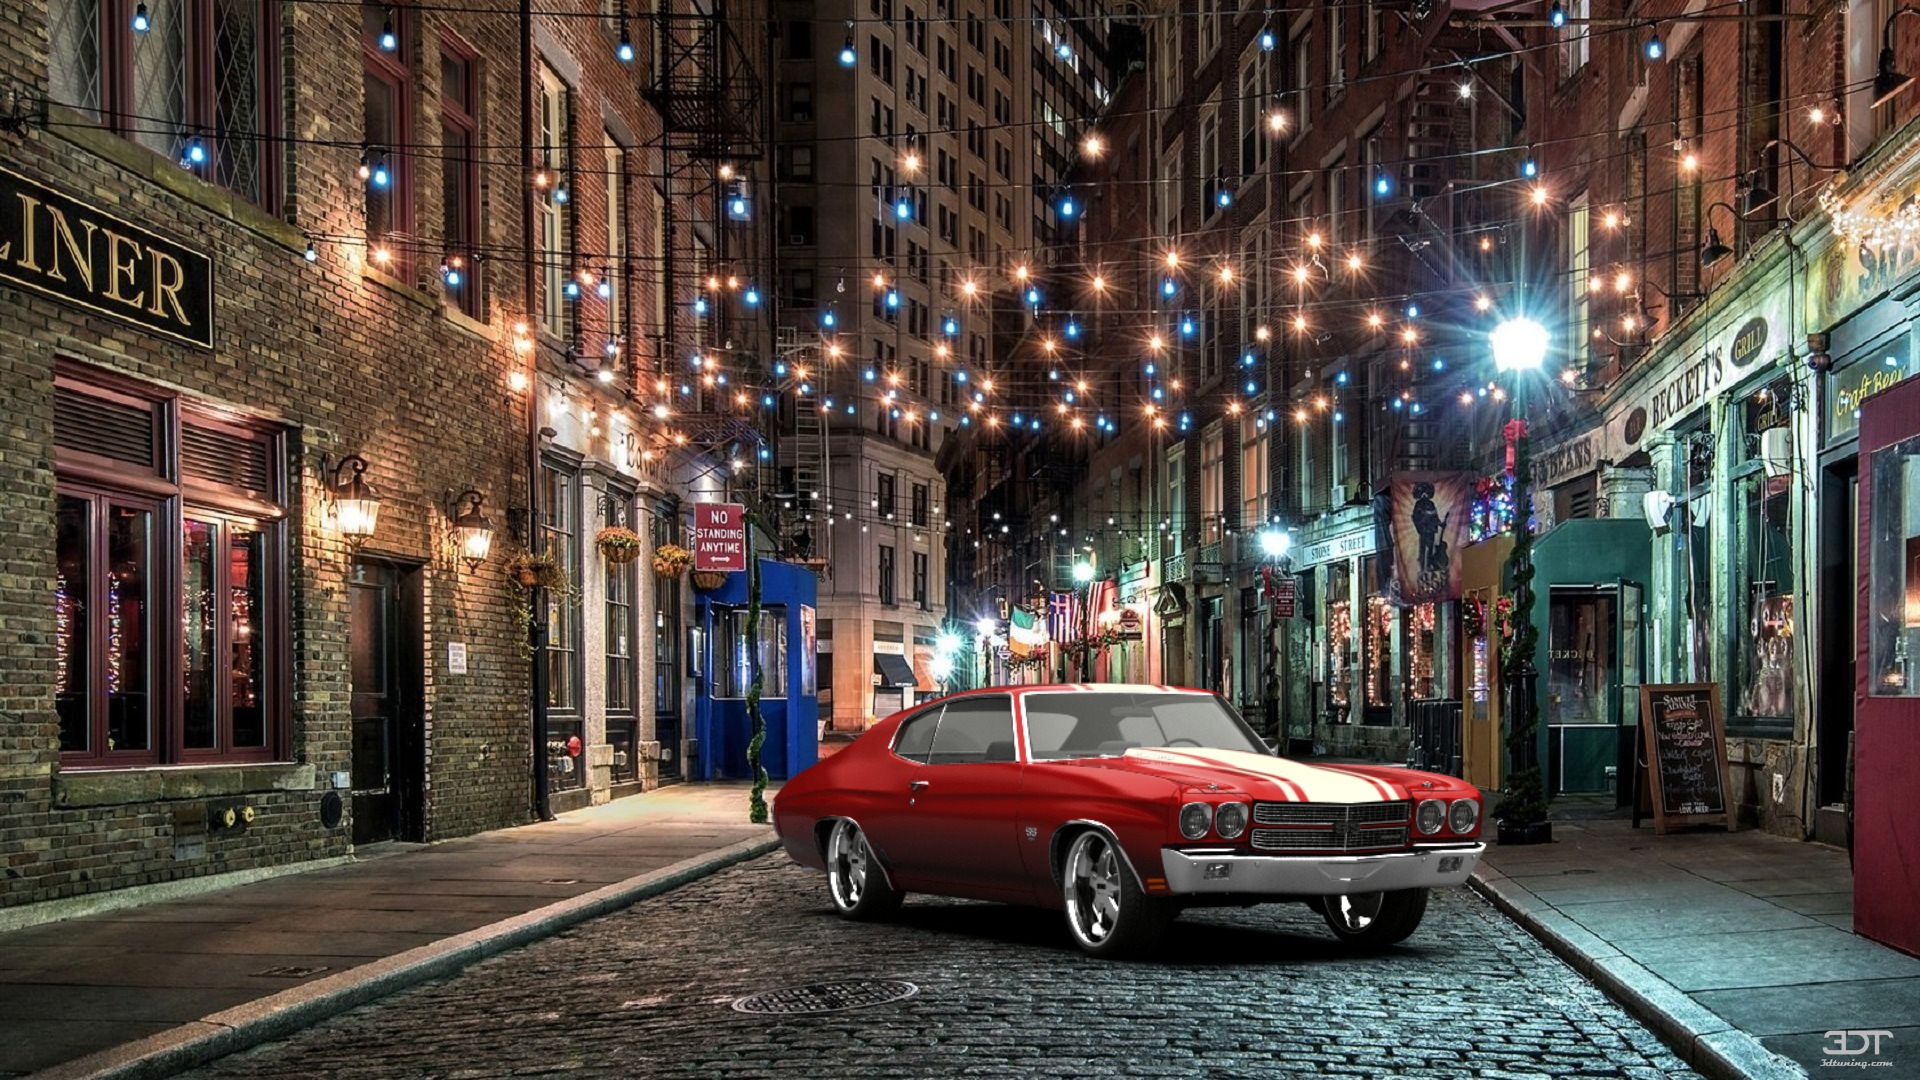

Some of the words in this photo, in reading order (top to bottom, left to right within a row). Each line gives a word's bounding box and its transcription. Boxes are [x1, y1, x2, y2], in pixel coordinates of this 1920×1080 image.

[1735, 326, 1762, 361] GRILL
[1652, 346, 1723, 428] BECKETT'S
[1837, 373, 1871, 416] Craft
[711, 510, 728, 524] NO
[696, 528, 743, 540] STANDING
[700, 541, 740, 553] ANYTIME
[1311, 544, 1330, 561] STONE
[1340, 535, 1365, 553] STREET
